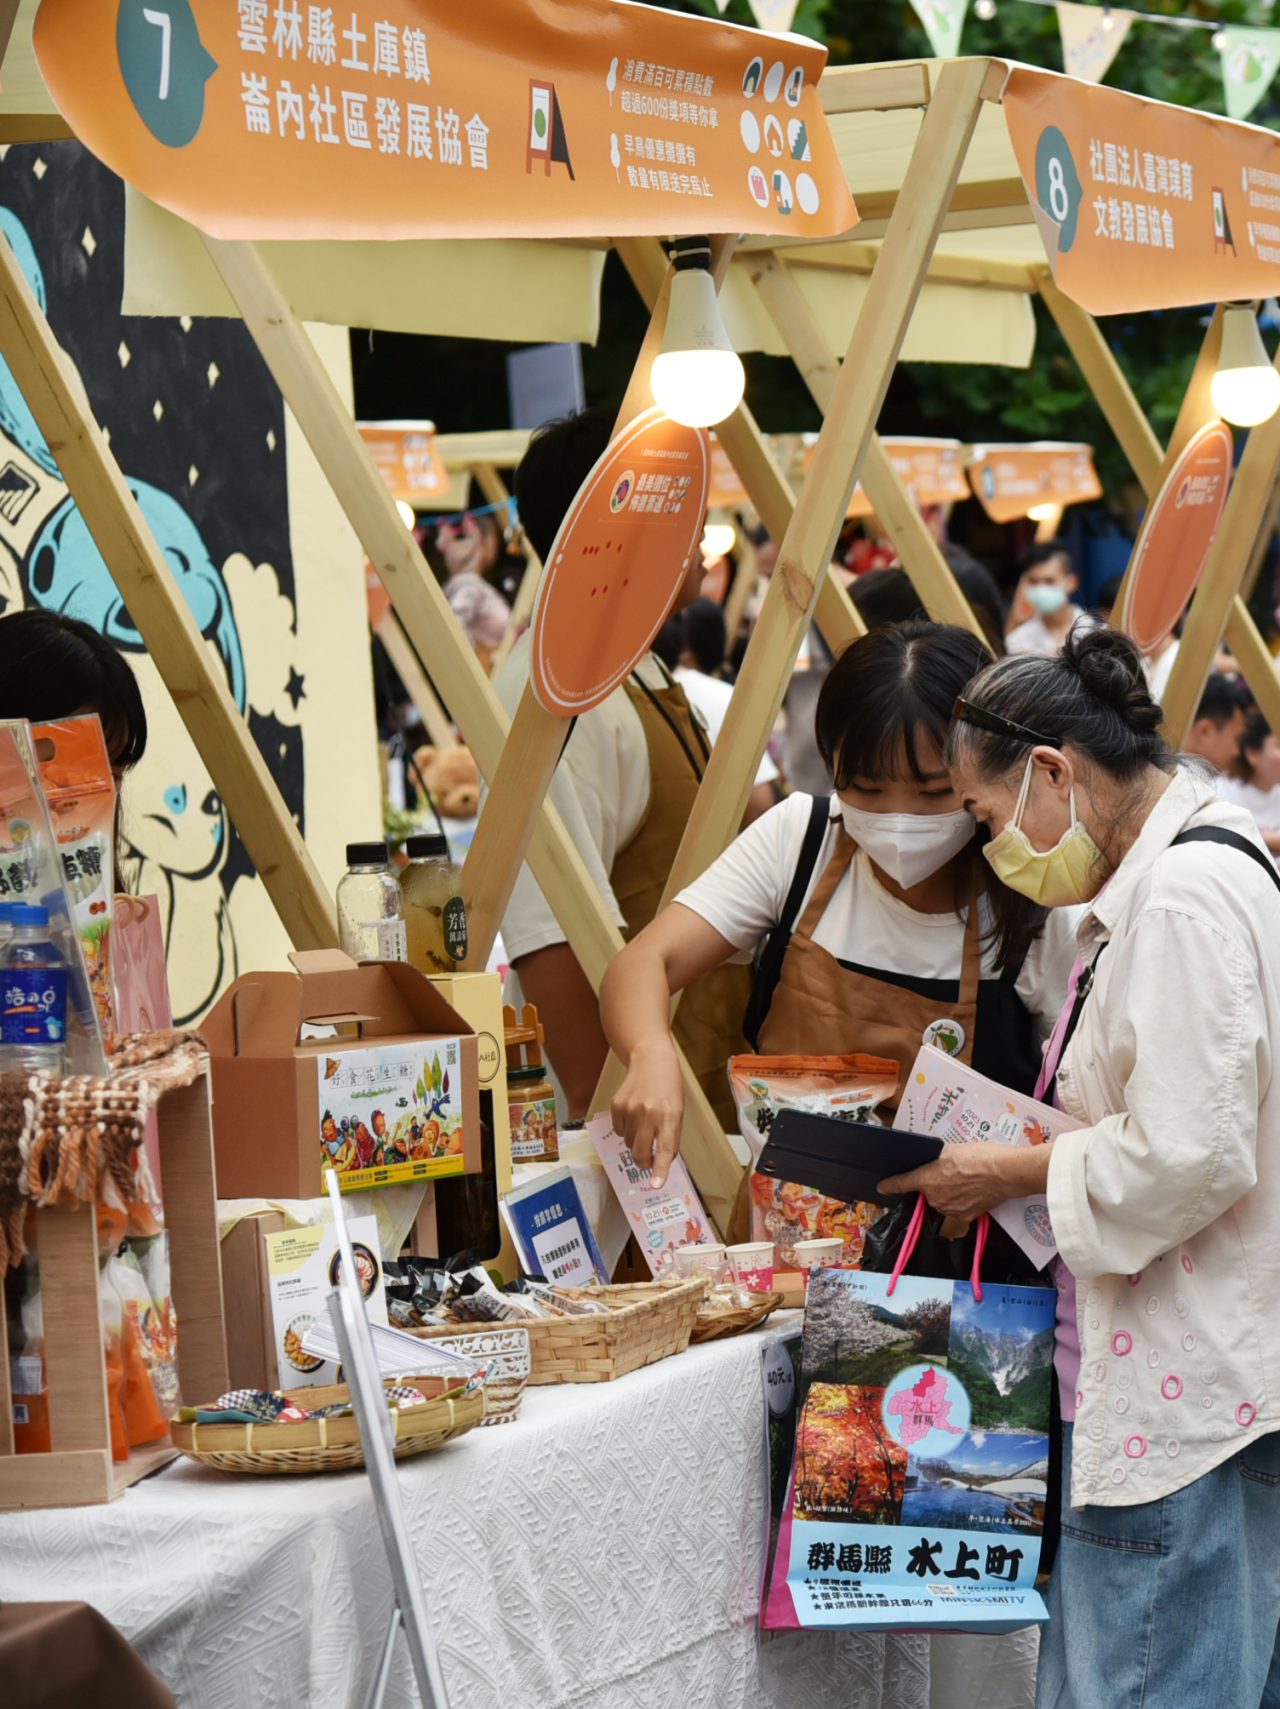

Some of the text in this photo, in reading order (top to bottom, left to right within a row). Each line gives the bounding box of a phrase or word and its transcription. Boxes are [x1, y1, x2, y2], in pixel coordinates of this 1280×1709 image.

[143, 8, 170, 100] 7
[236, 0, 430, 85] 雲林縣土庫鎮
[240, 72, 489, 170] 崙內社區發展協會
[1048, 157, 1069, 221] 8
[1093, 194, 1175, 250] 文教發展協會
[909, 1399, 939, 1413] 水上
[913, 1415, 934, 1426] 群馬
[807, 1537, 1024, 1582] 群馬縣 水上町
